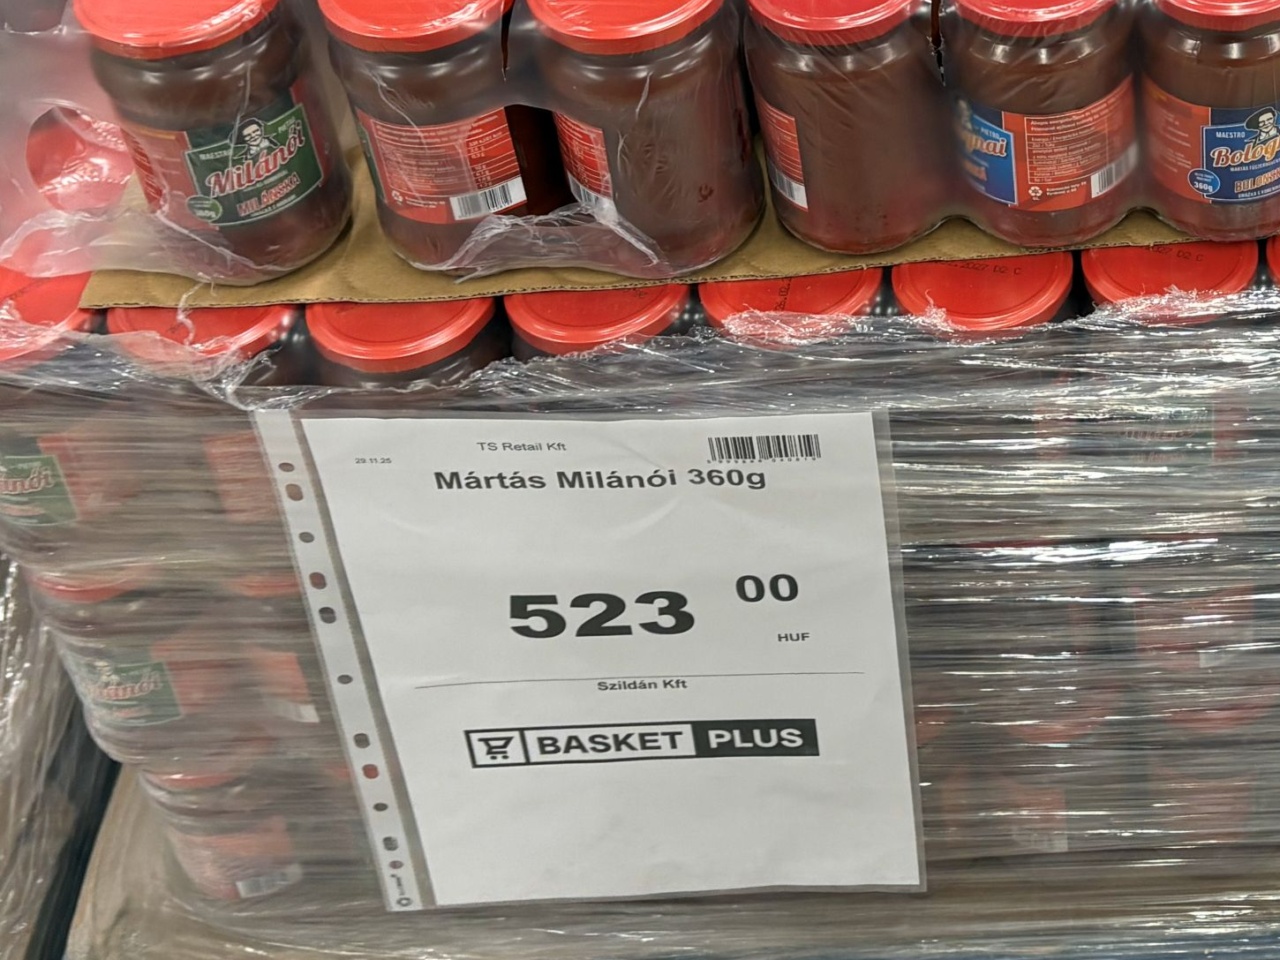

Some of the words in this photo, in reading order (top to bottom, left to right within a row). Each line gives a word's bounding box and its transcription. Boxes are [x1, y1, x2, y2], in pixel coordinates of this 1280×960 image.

[1215, 131, 1246, 139] MAESTRO
[205, 120, 305, 198] Milánói
[1193, 181, 1213, 193] 360g
[1197, 253, 1205, 262] C
[1014, 267, 1022, 276] C
[476, 442, 498, 451] TS
[502, 442, 542, 451] Retail
[546, 442, 567, 451] Kft
[434, 471, 547, 490] Mártás
[556, 469, 677, 489] Milánói
[687, 468, 766, 490] 360g
[735, 573, 799, 602] 00
[510, 591, 695, 639] 523
[777, 632, 810, 642] HUF
[597, 679, 658, 691] Szildán
[662, 679, 688, 690] Kft
[537, 731, 683, 756] BASKET
[708, 728, 803, 749] PLUS
